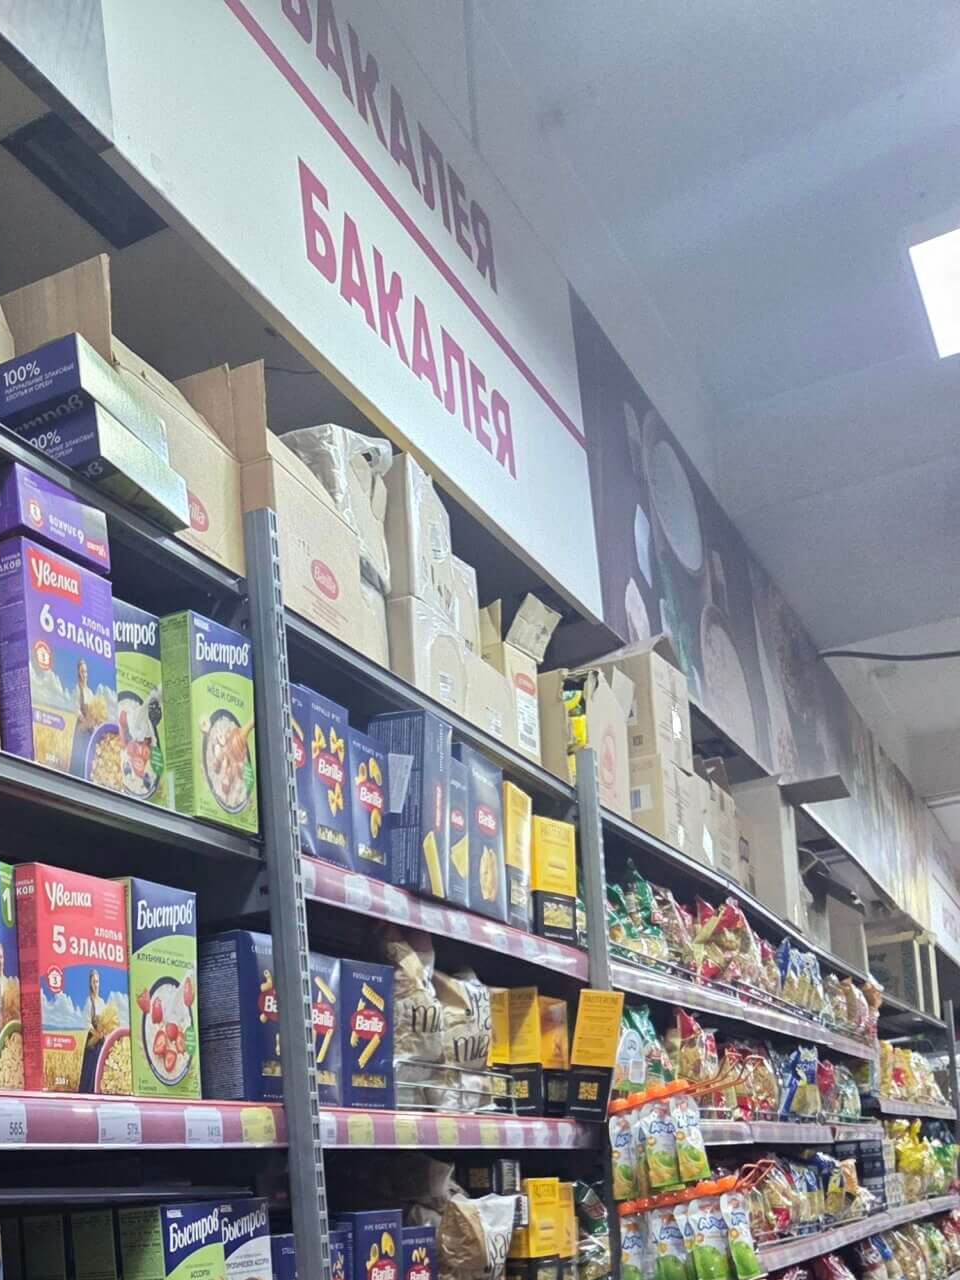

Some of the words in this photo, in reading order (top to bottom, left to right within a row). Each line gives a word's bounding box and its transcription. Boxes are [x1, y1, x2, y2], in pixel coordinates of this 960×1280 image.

[298, 155, 517, 480] БАКАЛЕЯ
[3, 360, 41, 387] 100%
[31, 556, 80, 596] Увелка
[39, 603, 55, 633] 6
[56, 618, 113, 659] ЗЛАКОВ
[81, 615, 110, 637] ХЛОПЬЯ
[194, 632, 250, 670] Быстров
[317, 756, 344, 784] Barilla
[359, 784, 384, 808] Barilla
[478, 809, 497, 830] Barilla
[1, 886, 12, 922] 1
[44, 880, 92, 911] Увелка
[136, 899, 193, 932] Быстров
[52, 924, 66, 955] 5
[69, 937, 124, 964] ЗЛАКОВ
[94, 926, 123, 943] ХЛОПЬЯ
[355, 1014, 384, 1033] Barilla
[169, 1206, 219, 1252] Быстров
[221, 1202, 267, 1244] Быстров
